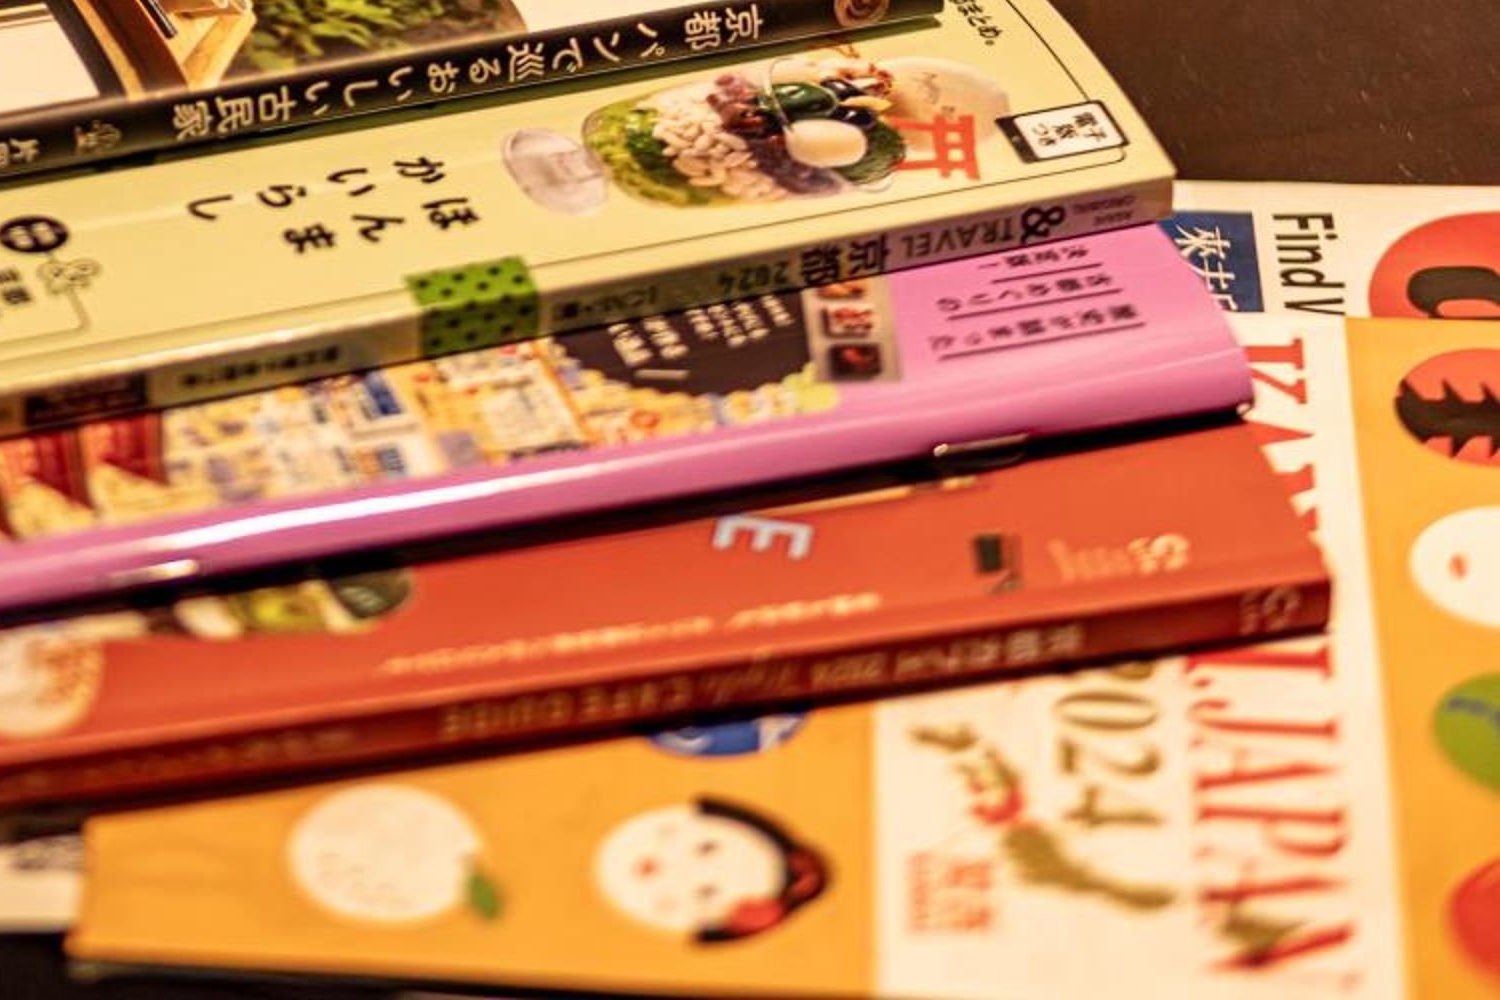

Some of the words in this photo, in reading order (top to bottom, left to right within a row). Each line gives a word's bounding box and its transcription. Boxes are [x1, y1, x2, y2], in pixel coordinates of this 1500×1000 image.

[684, 3, 763, 50] 京都
[186, 156, 446, 221] かいらし
[282, 196, 481, 255] ほんま
[900, 223, 1020, 262] TRAVEL
[1272, 212, 1347, 289] Find
[802, 232, 891, 286] 京都
